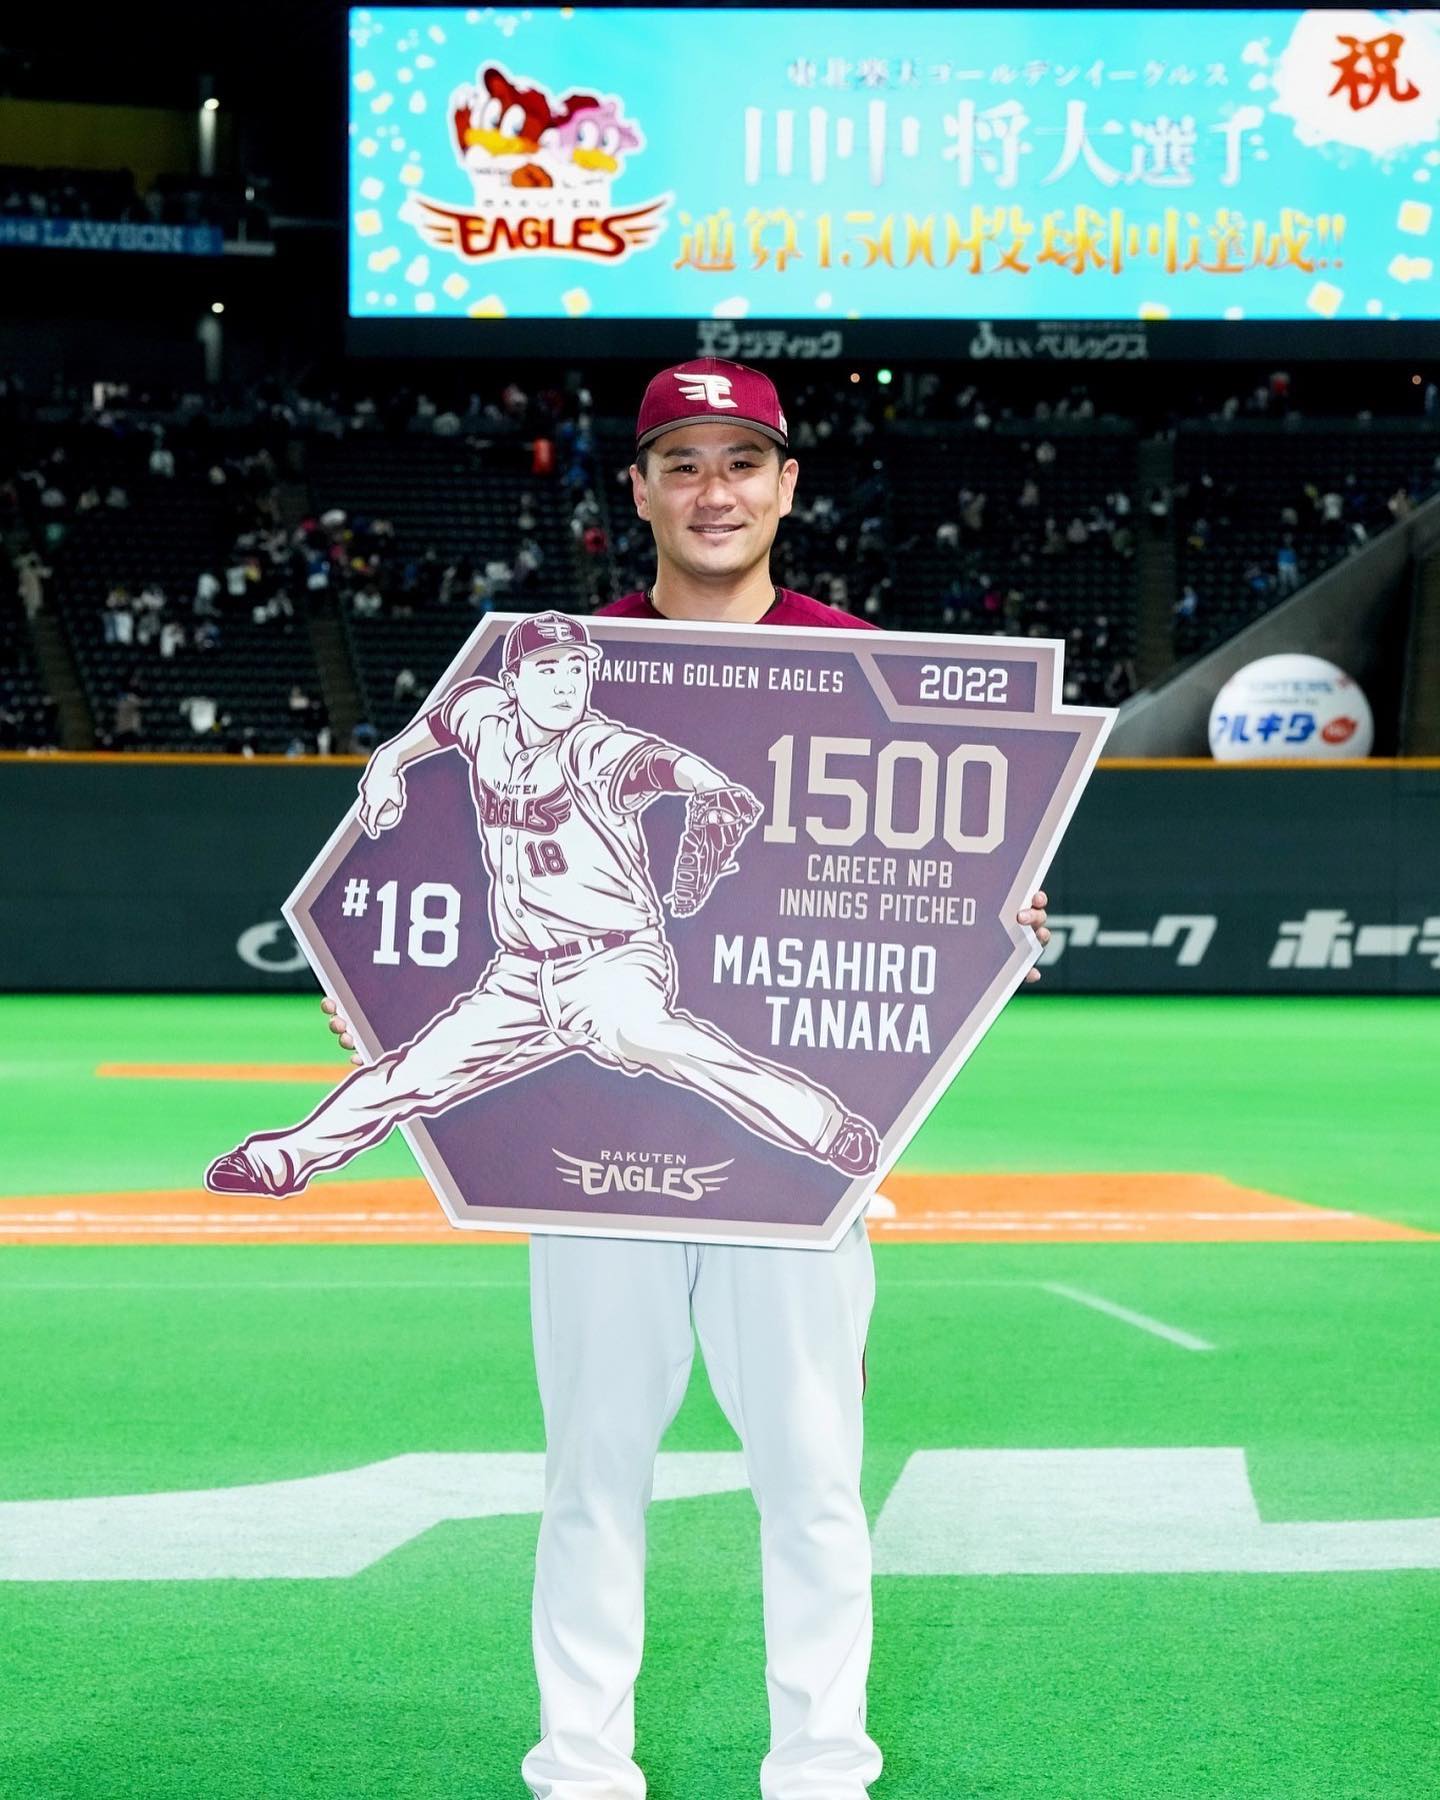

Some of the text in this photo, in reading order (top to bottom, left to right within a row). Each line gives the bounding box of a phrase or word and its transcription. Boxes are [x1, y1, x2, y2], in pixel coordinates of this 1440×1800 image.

[1327, 32, 1420, 111] 祝
[445, 209, 640, 258] EAGLES
[592, 659, 844, 693] RAKUTEN GOLDEN EAGLES
[919, 664, 1009, 703] 2022
[763, 734, 1009, 854] 1500
[525, 840, 569, 878] 18
[807, 854, 953, 889] CAREER NPB
[778, 888, 977, 926] INNINGS PITCHED
[711, 934, 937, 995] MASAHIRO
[765, 996, 931, 1054] TANAKA
[599, 1149, 687, 1165] RAKUTEN
[570, 1161, 715, 1201] EAGLES
